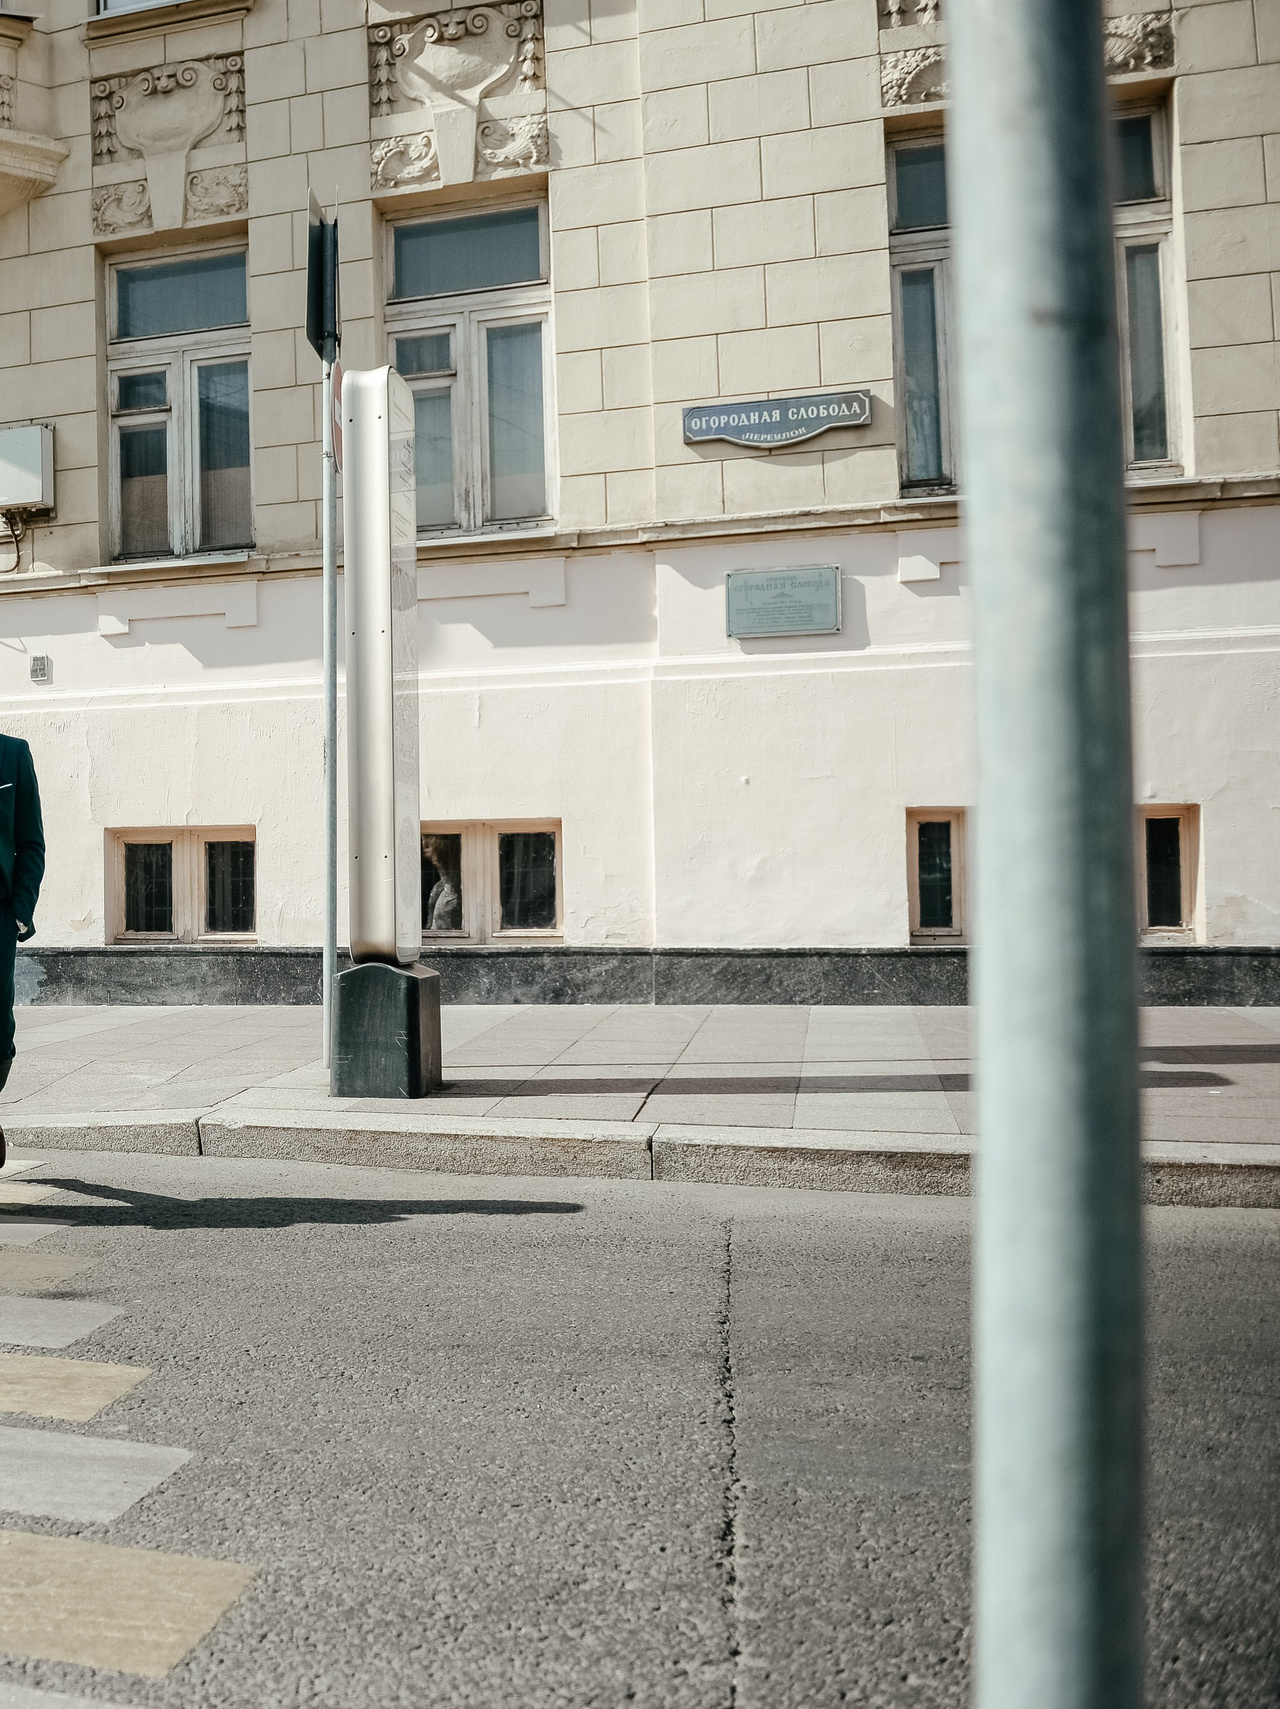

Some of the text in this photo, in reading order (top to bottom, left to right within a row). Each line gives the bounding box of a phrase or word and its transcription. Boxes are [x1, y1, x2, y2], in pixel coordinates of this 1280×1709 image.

[691, 402, 861, 431] ОГОРОДНАЯ СЛОБОДА
[745, 426, 807, 441] ПЕРЕУЛОК
[734, 580, 831, 592] ОГОРОДНАЯ СЛОБОДА
